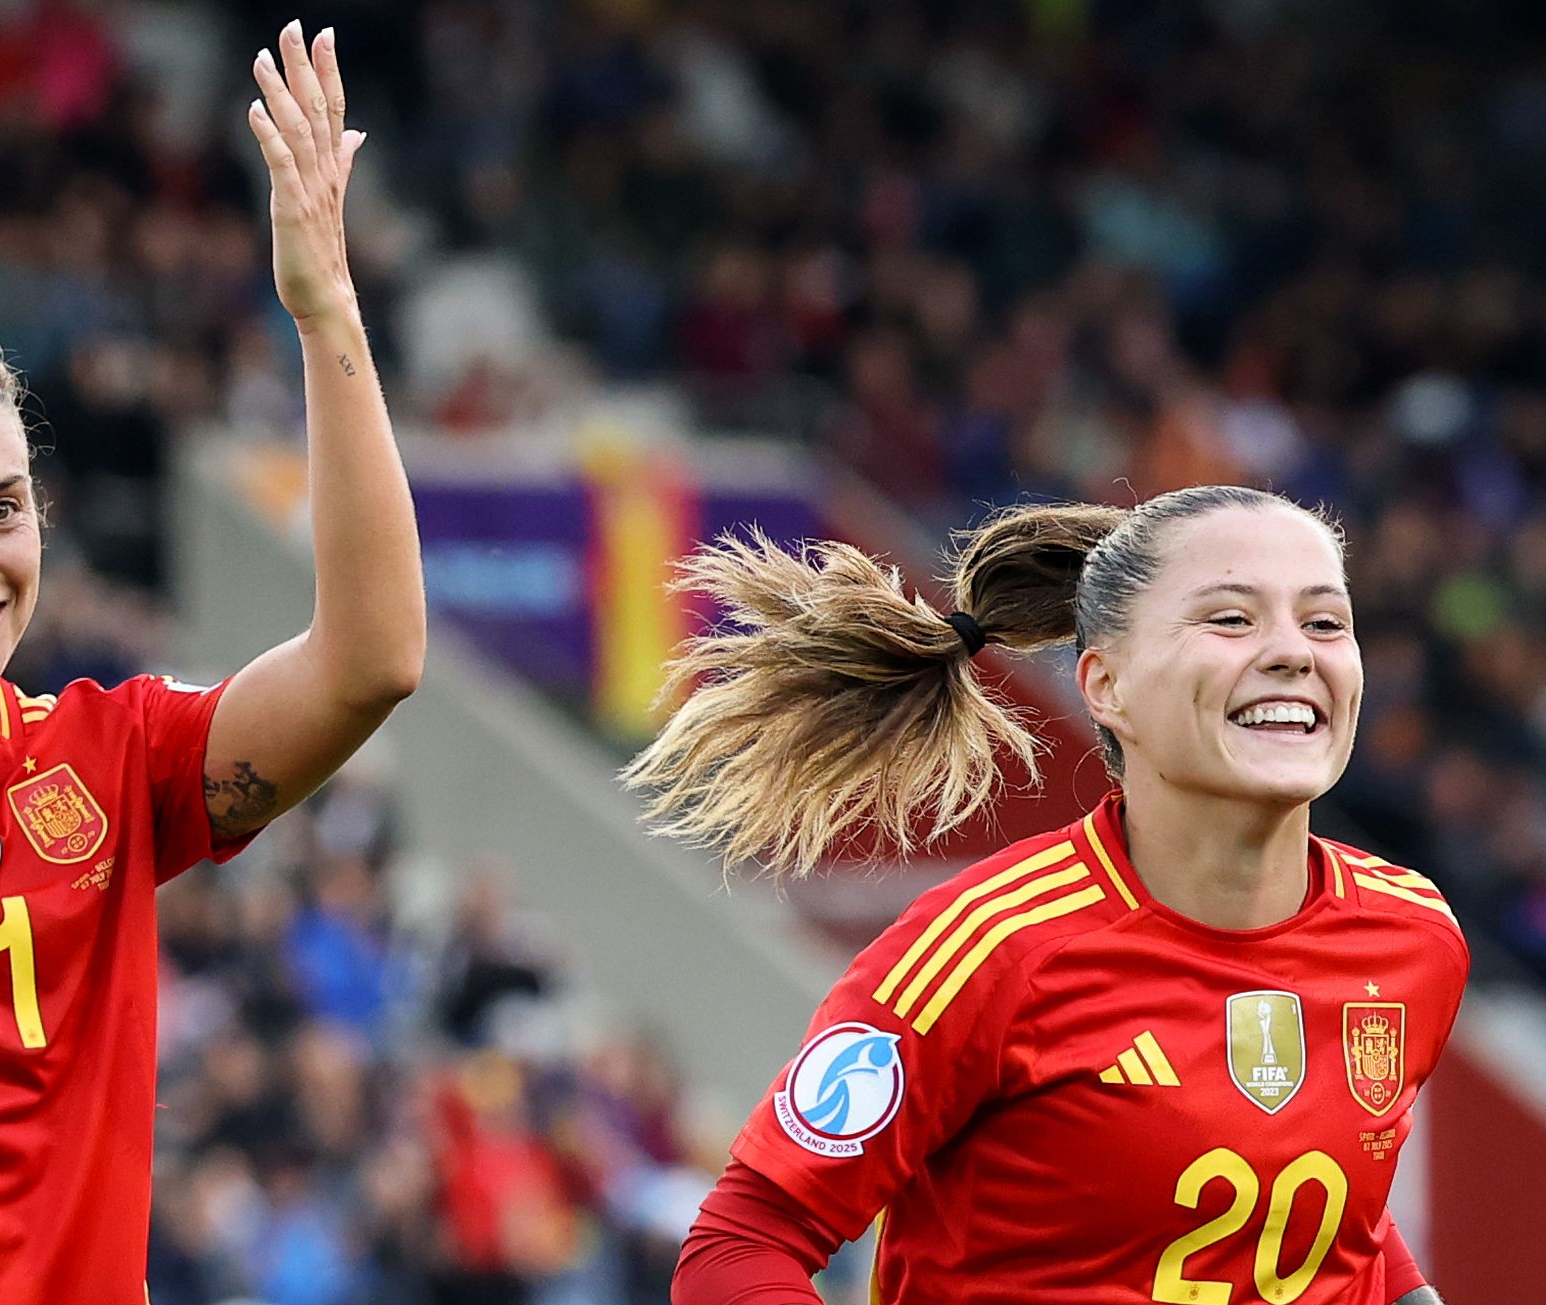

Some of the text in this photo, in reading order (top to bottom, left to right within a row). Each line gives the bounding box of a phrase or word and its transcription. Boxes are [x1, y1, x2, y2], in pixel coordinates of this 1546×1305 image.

[1252, 1066, 1287, 1081] FIFA
[778, 1095, 858, 1153] SWITZERLAND 2025
